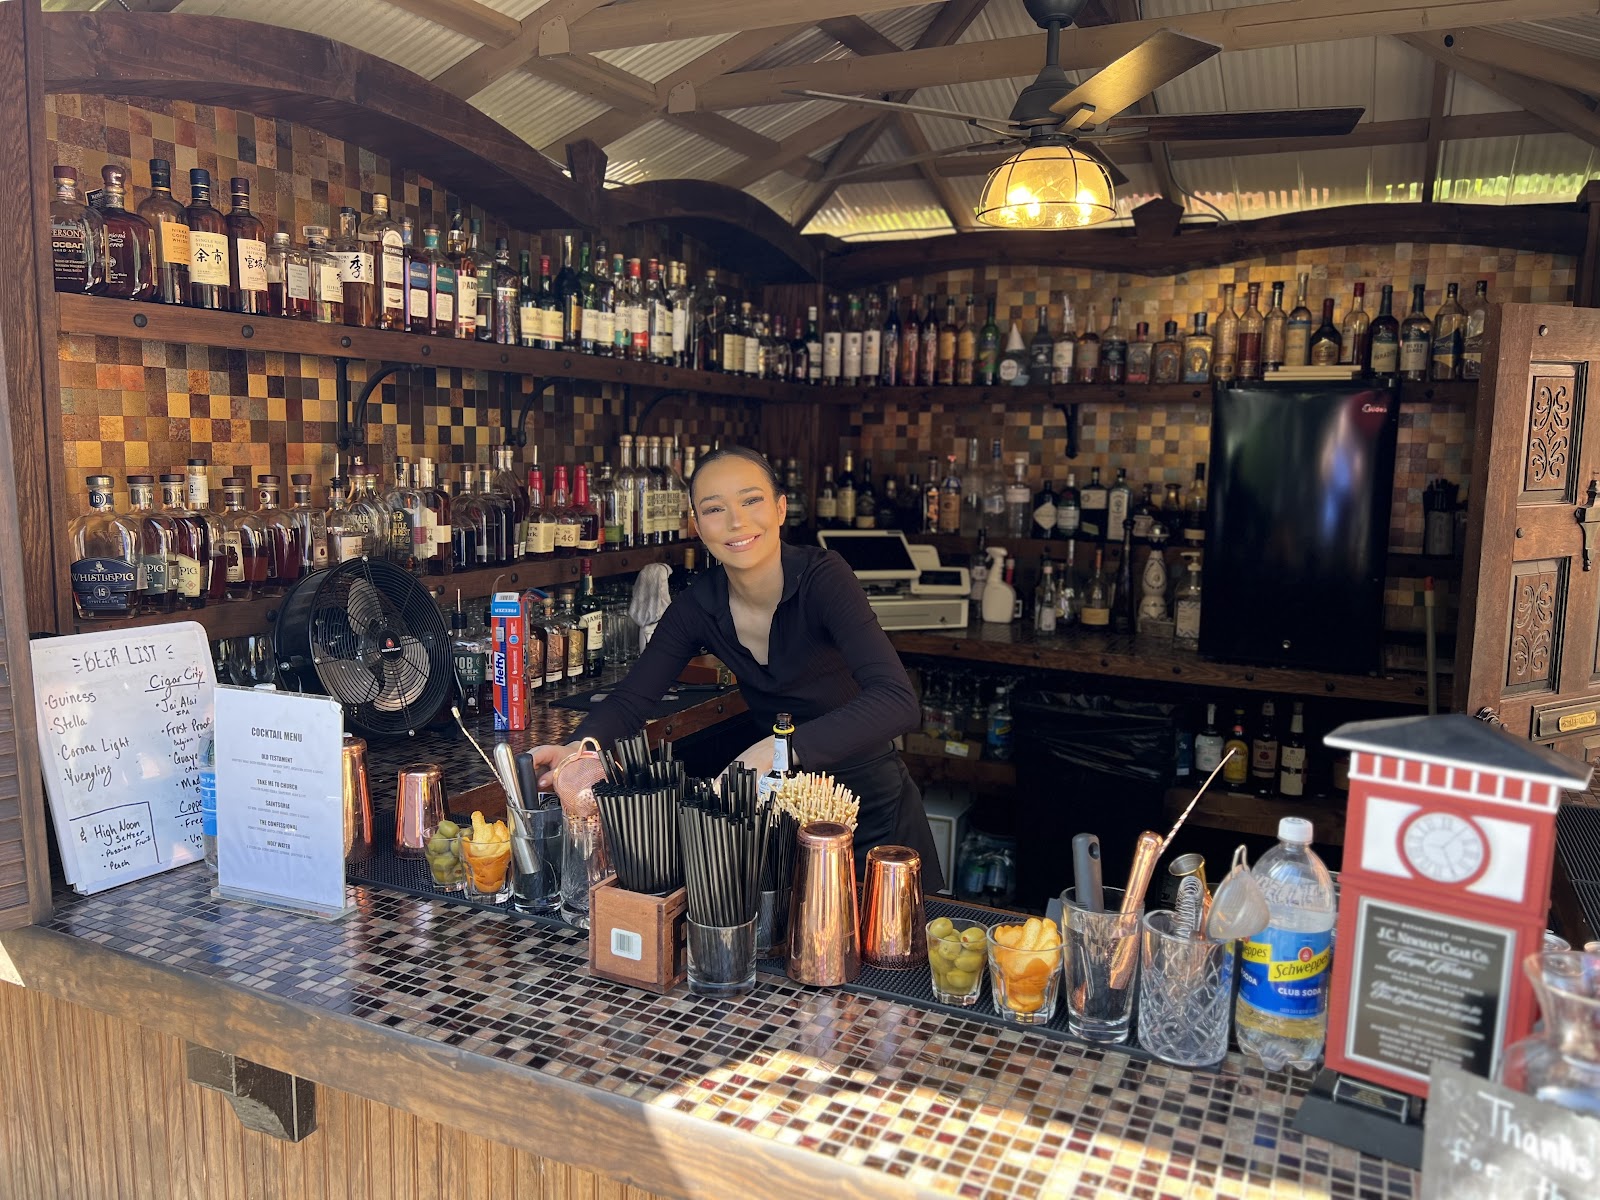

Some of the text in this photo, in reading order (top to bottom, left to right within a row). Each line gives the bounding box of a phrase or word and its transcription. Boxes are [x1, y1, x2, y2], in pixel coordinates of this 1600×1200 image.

[194, 247, 224, 265] 余市
[92, 495, 100, 503] 15
[561, 534, 574, 542] 46
[71, 572, 135, 582] WHISTLEPIG
[98, 588, 106, 597] 15
[84, 644, 156, 672] BEER LIST
[494, 653, 506, 685] Hefty
[149, 665, 204, 700] Cigar City
[48, 691, 97, 709] Guiness
[161, 694, 198, 712] Jai Alai
[53, 714, 87, 734] Stella
[251, 726, 303, 742] COCKTAIL MENU
[61, 736, 129, 760] Corona Light
[269, 754, 293, 763] TESTAMENT
[65, 765, 112, 792] Yuengling
[180, 775, 200, 789] Mad
[257, 778, 268, 786] TAKE
[280, 782, 298, 790] CHURCH
[179, 800, 202, 815] Coppe
[94, 824, 118, 847] High
[119, 819, 141, 832] Noon
[267, 820, 298, 831] CONFESSIONAL
[277, 842, 291, 850] WATER
[1278, 987, 1322, 997] CLUB SODA
